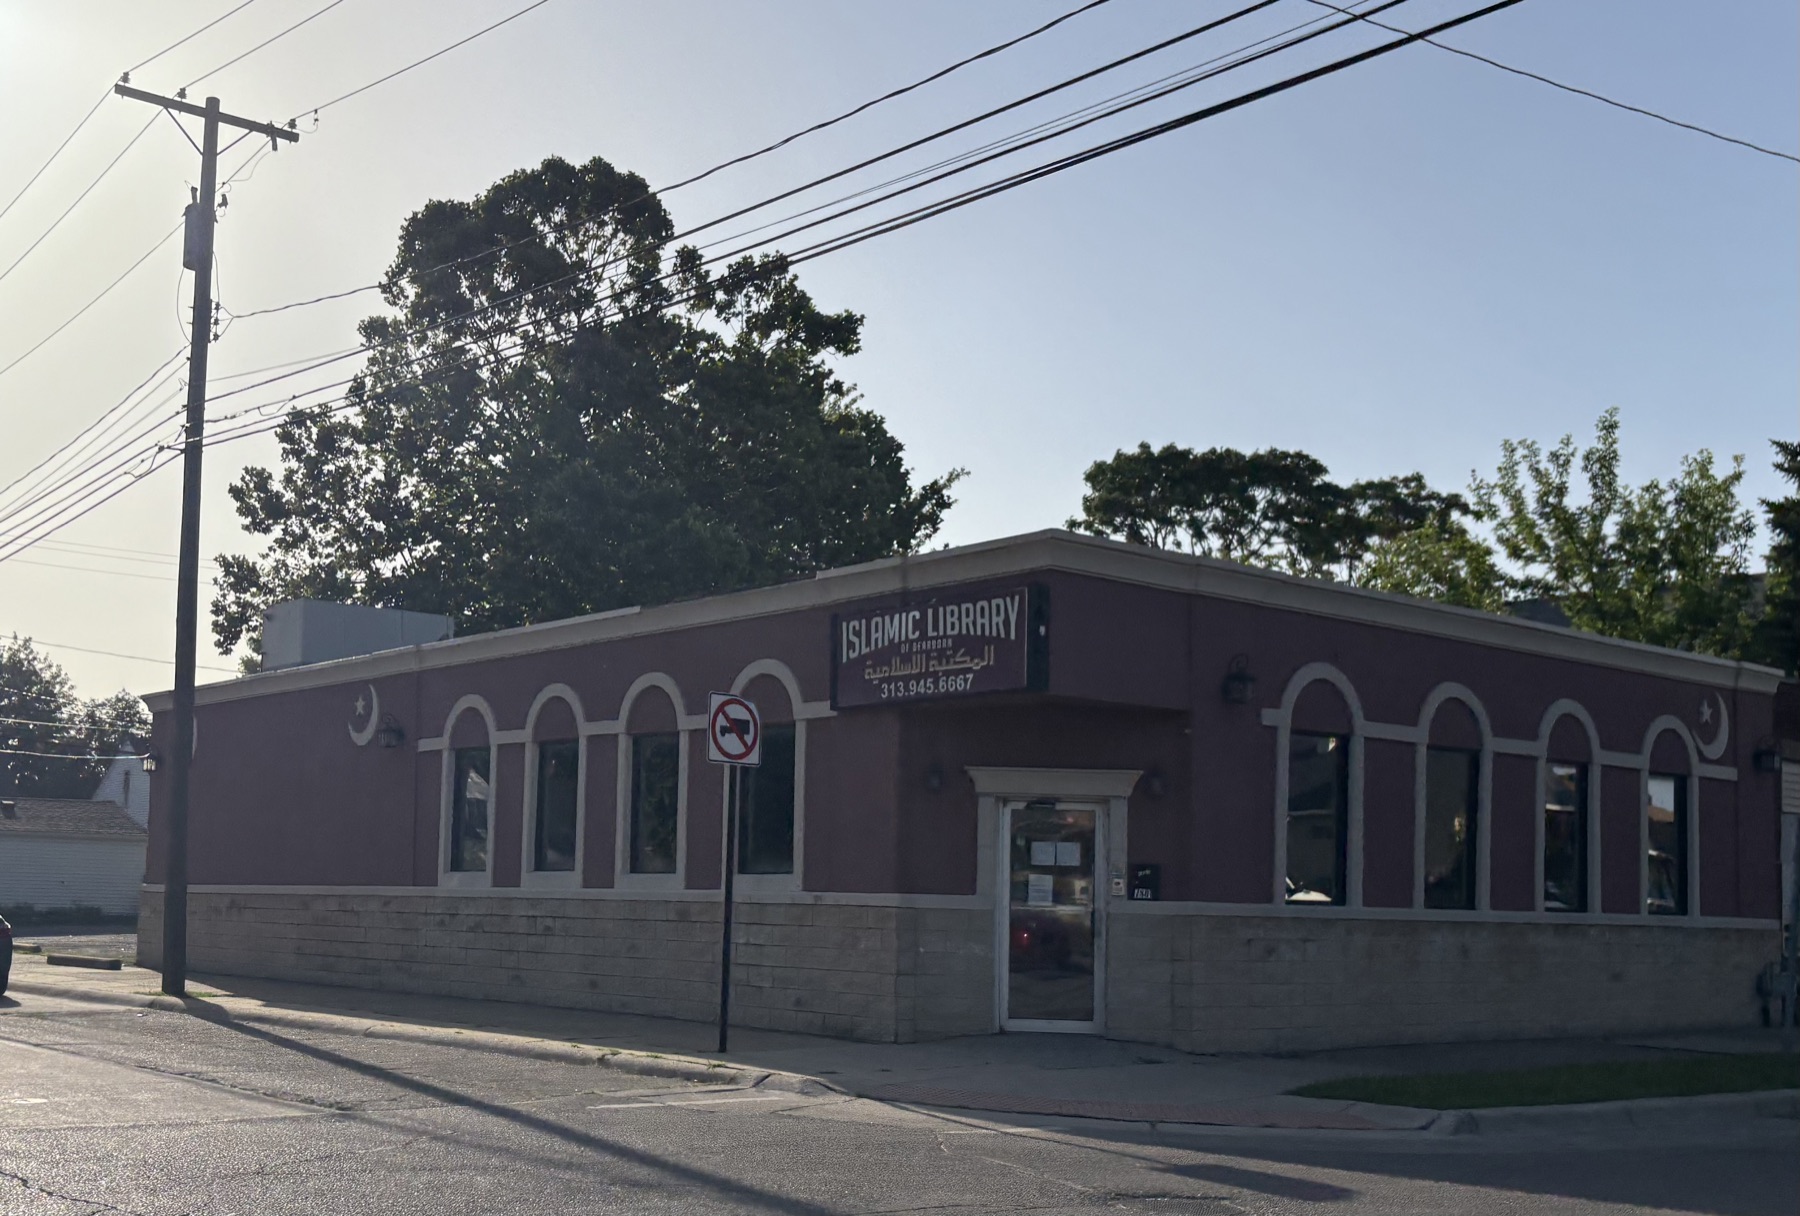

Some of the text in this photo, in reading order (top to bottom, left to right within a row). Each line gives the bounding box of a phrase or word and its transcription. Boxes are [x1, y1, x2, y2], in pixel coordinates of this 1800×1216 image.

[842, 595, 1020, 663] ISLAMIC LIBRARY
[901, 642, 909, 654] OF
[928, 644, 995, 676] المكتبة
[881, 673, 974, 699] 313.945.6667
